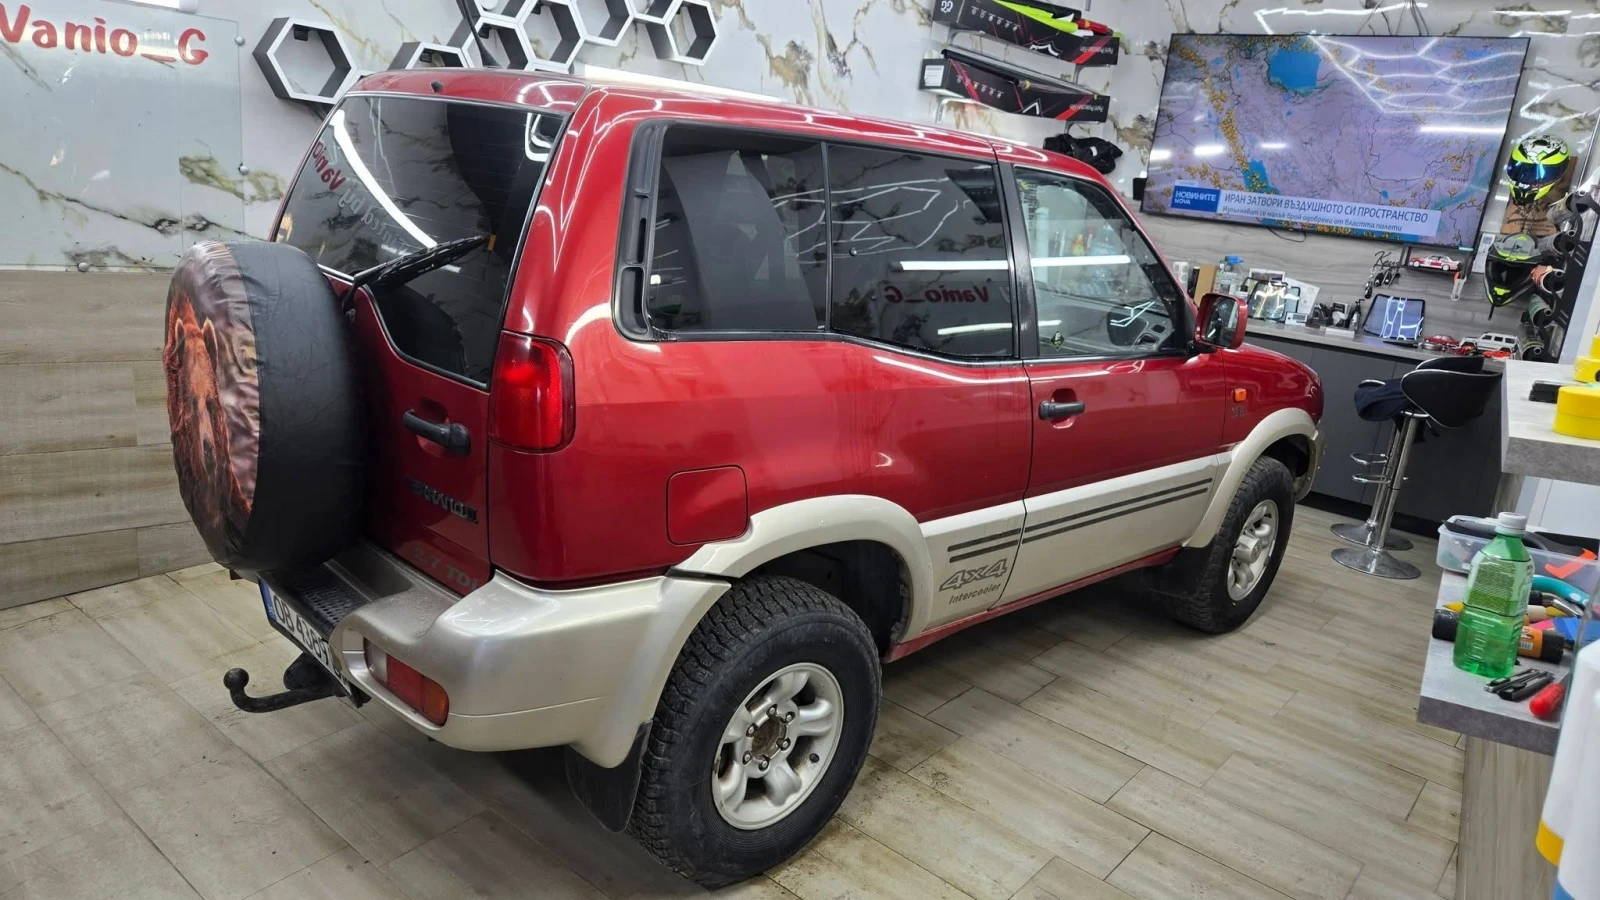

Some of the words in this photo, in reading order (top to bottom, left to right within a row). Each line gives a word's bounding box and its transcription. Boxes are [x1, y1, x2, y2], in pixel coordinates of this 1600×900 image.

[0, 3, 209, 65] Vanio_G
[1175, 190, 1217, 202] НОВИНИТЕ
[1224, 193, 1246, 204] ИРАН
[1246, 195, 1283, 208] ЗАТВОРИ
[1284, 199, 1344, 215] ВЪЗДУШНОТО
[1344, 205, 1357, 216] СИ
[1357, 206, 1429, 223] ПРОСТРАНСТВО
[1287, 212, 1302, 222] брой
[1375, 222, 1403, 232] полети
[938, 558, 1008, 592] 4x4
[948, 583, 1001, 605] Intercooler
